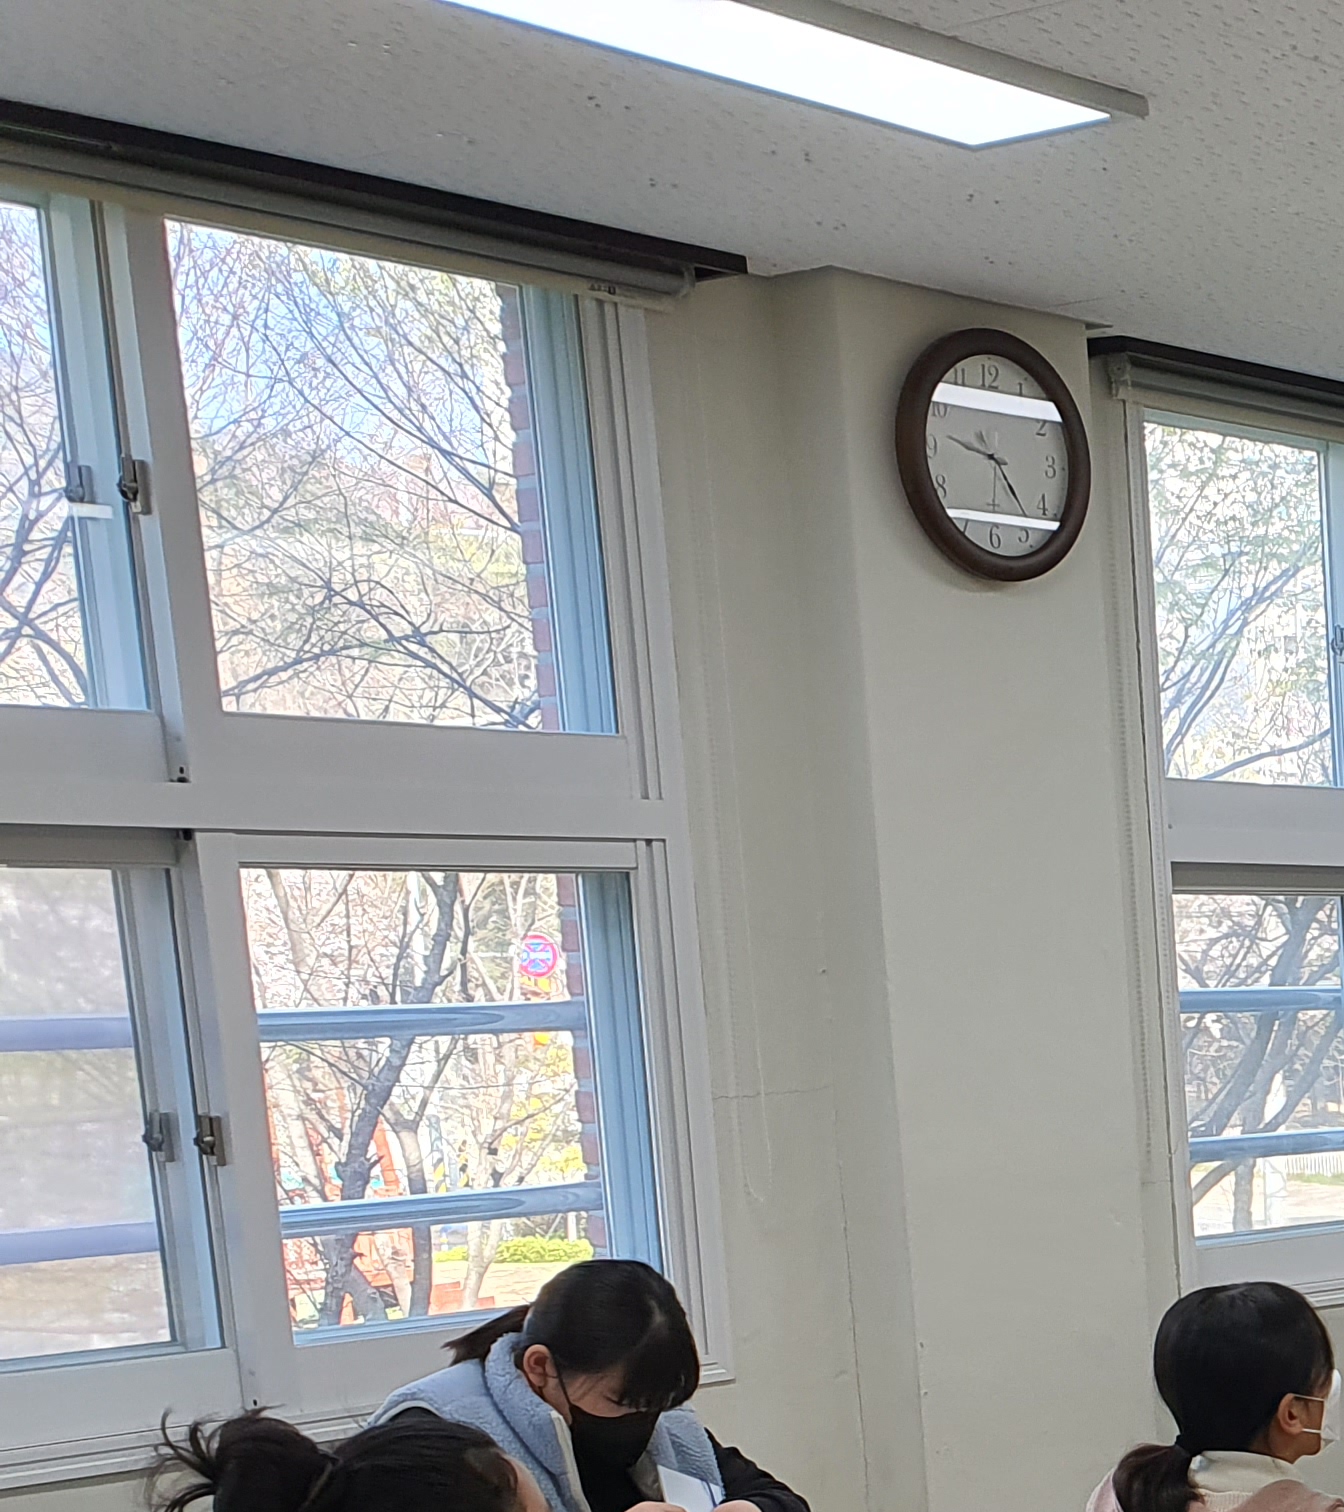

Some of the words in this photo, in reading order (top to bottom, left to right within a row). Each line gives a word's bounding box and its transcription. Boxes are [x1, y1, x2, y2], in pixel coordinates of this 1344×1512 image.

[980, 364, 999, 389] 12
[926, 434, 938, 459] 9
[1044, 455, 1057, 479] 3
[935, 474, 947, 499] 8
[1037, 493, 1048, 517] 4
[989, 524, 1001, 549] 6
